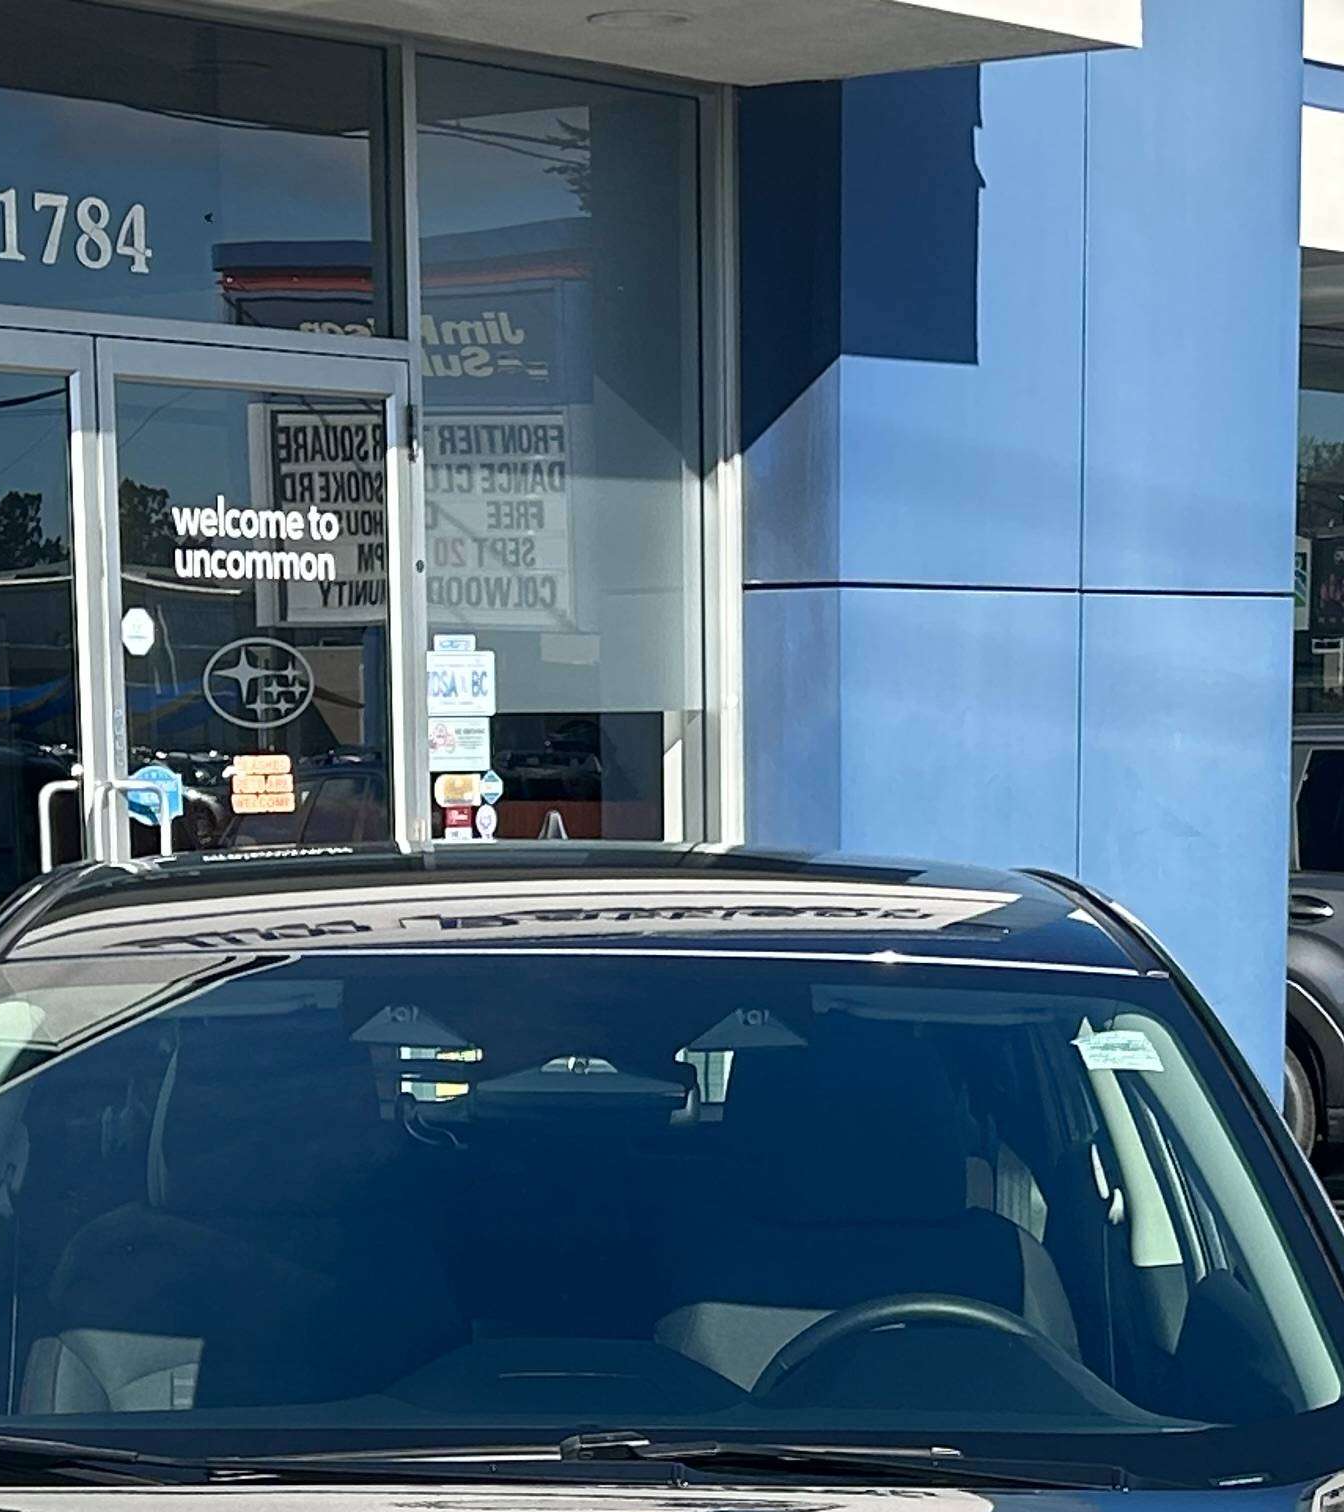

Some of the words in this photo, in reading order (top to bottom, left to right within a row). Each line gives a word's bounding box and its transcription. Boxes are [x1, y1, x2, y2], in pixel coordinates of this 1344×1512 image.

[172, 494, 303, 540] welcome
[308, 503, 339, 541] to
[173, 547, 336, 582] uncommon
